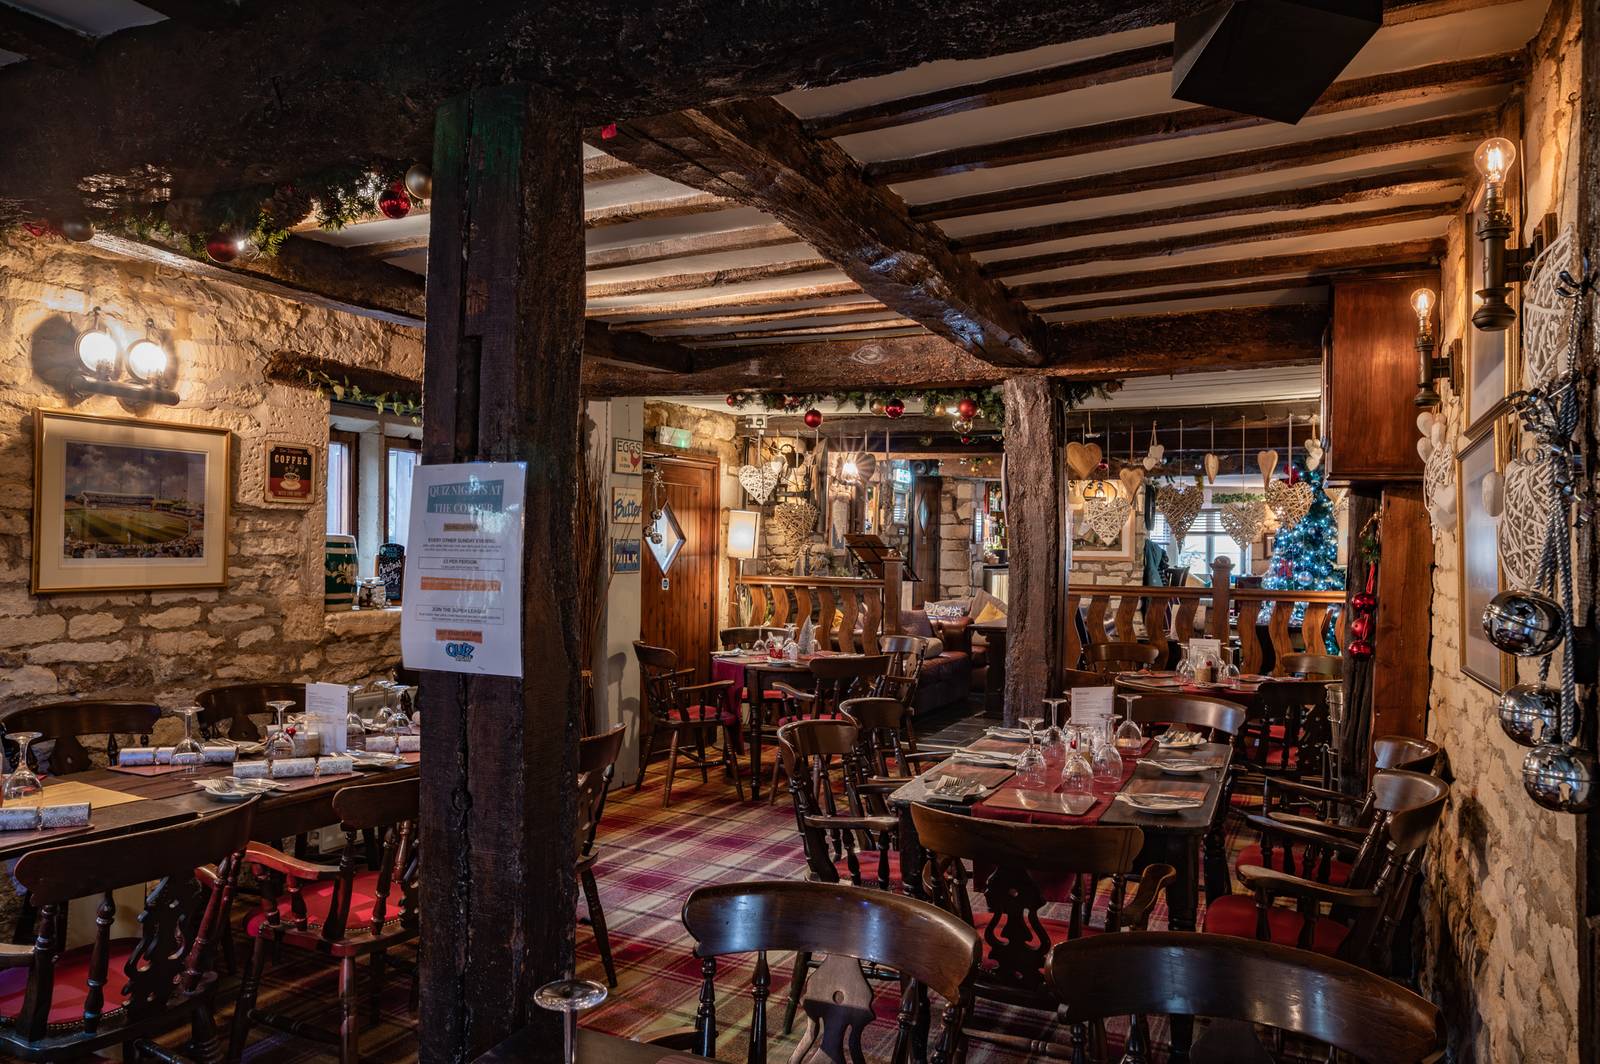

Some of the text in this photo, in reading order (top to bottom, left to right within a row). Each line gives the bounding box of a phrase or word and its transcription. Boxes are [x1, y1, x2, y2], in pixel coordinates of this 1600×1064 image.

[617, 440, 641, 454] EGGS
[274, 454, 308, 465] COFFEE
[430, 485, 449, 497] QUIZ
[490, 483, 503, 495] AT
[435, 503, 452, 512] THE
[614, 498, 642, 520] Butter
[616, 553, 638, 563] MILK
[446, 642, 475, 657] QUIZ
